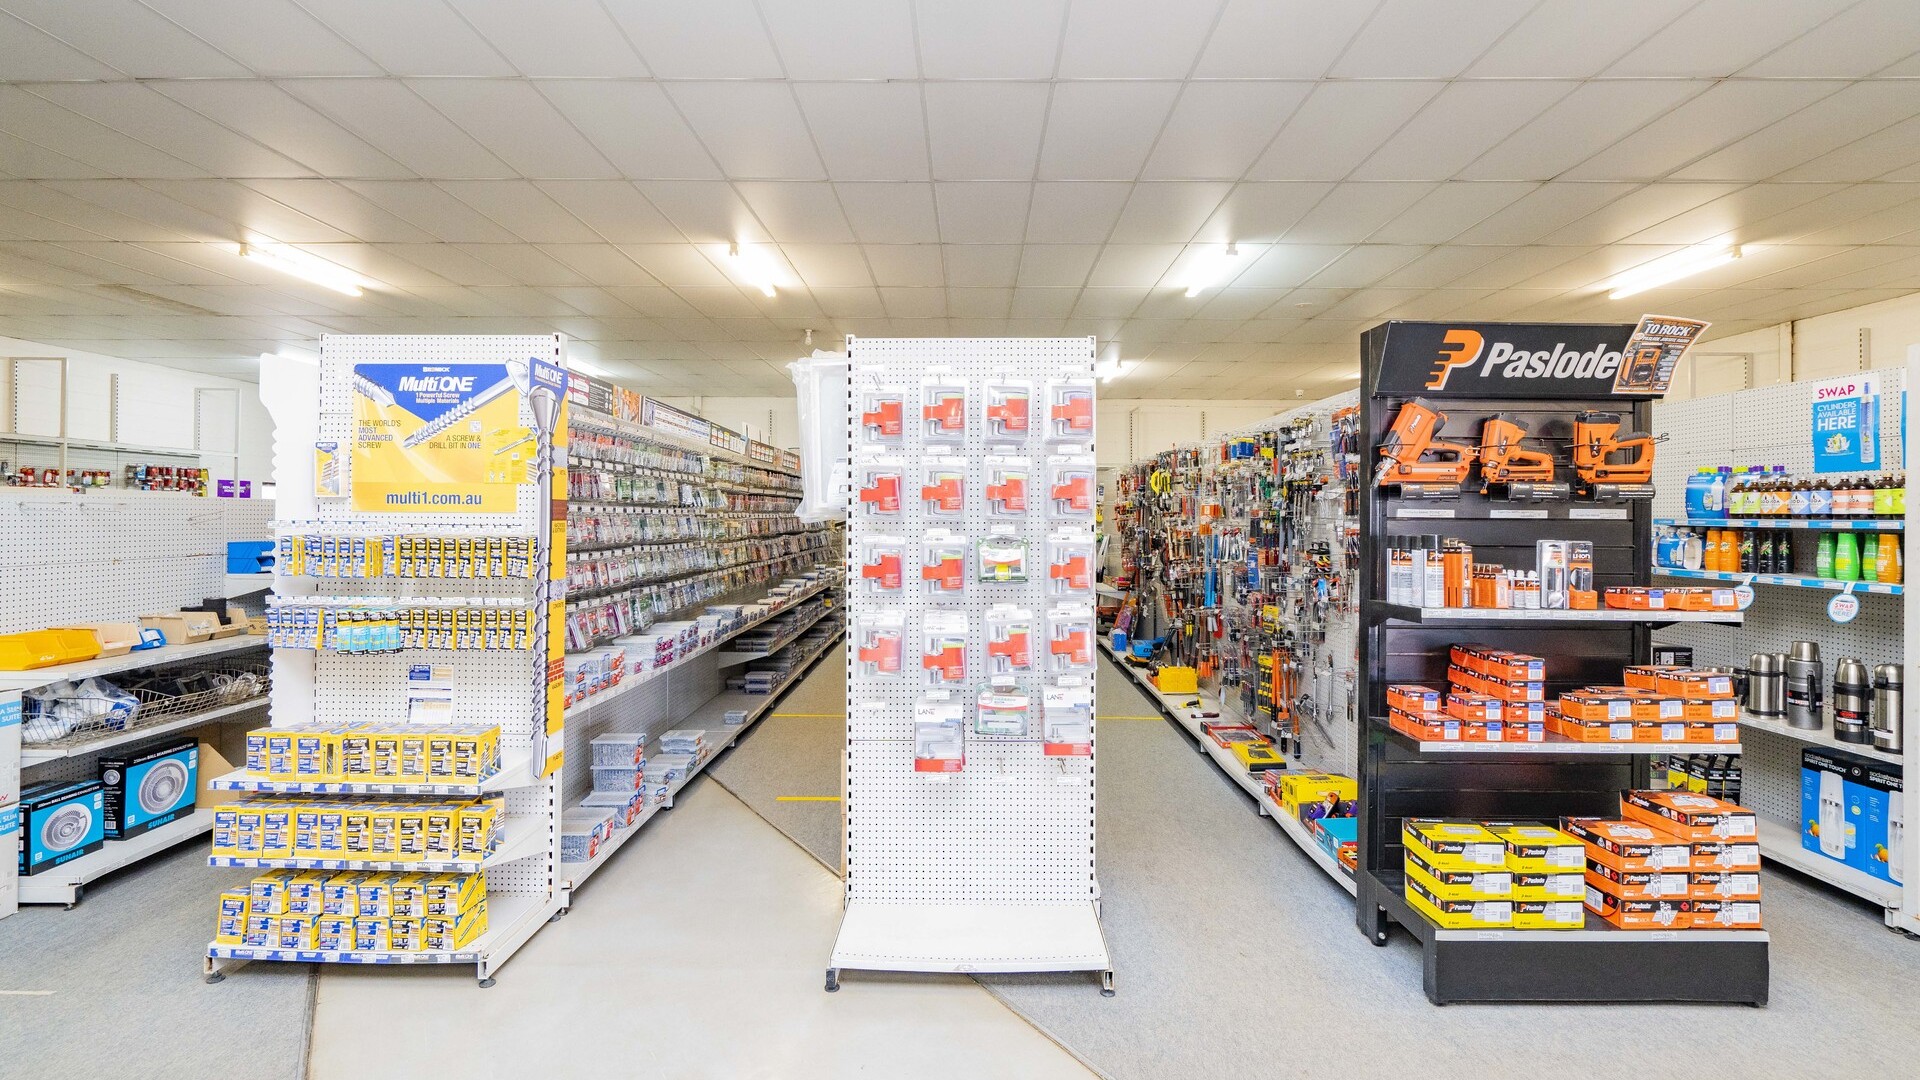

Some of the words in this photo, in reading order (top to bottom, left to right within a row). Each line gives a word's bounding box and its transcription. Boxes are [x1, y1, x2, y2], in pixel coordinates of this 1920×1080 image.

[1644, 323, 1660, 334] TO
[1479, 342, 1622, 379] Paslode
[1818, 384, 1855, 399] SWAP
[1817, 401, 1857, 412] CYLINDERS
[1817, 407, 1857, 418] AVAILABLE
[373, 419, 402, 427] WORLD'S
[1817, 415, 1856, 431] HERE
[358, 434, 393, 442] ADVANCED
[358, 441, 382, 449] SCREW
[386, 491, 482, 506] multi1.com.au
[1046, 693, 1064, 701] LANE
[147, 813, 175, 829] SUNAIR
[55, 848, 84, 864] SUNAIR
